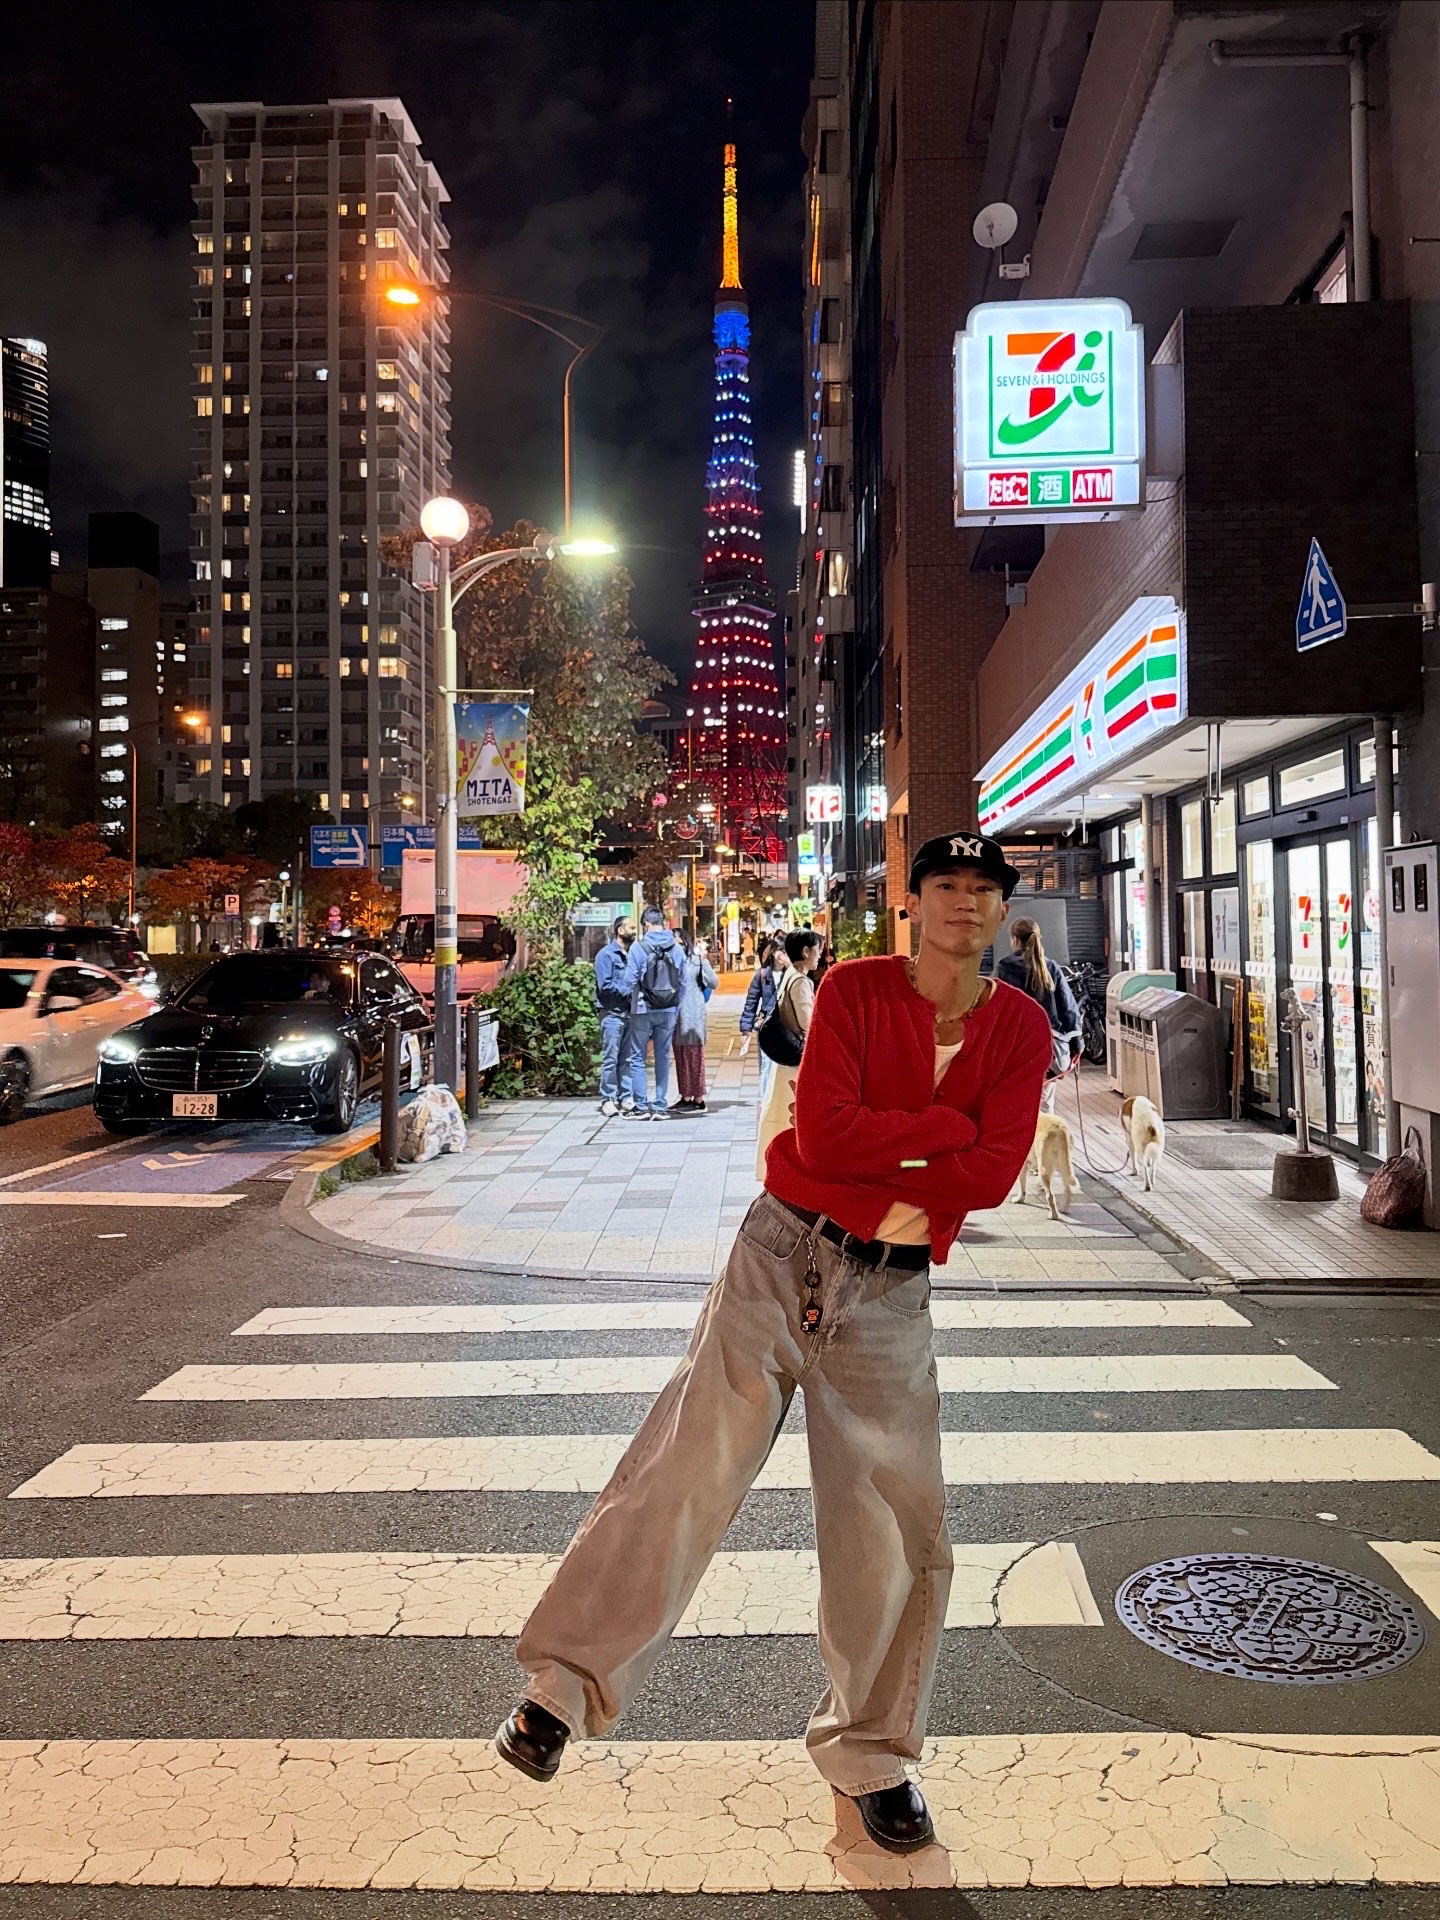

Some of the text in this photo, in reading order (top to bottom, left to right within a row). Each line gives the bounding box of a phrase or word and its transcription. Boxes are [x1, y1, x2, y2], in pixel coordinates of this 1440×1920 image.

[1048, 371, 1106, 384] HOLDINGS
[989, 475, 1028, 503] たばこ
[1037, 474, 1064, 502] 酒
[1074, 472, 1112, 500] ATM
[466, 778, 512, 797] MITA
[467, 795, 512, 806] SHOTENGAI
[948, 836, 984, 858] NY
[227, 896, 237, 907] P
[183, 1103, 215, 1115] 12-28
